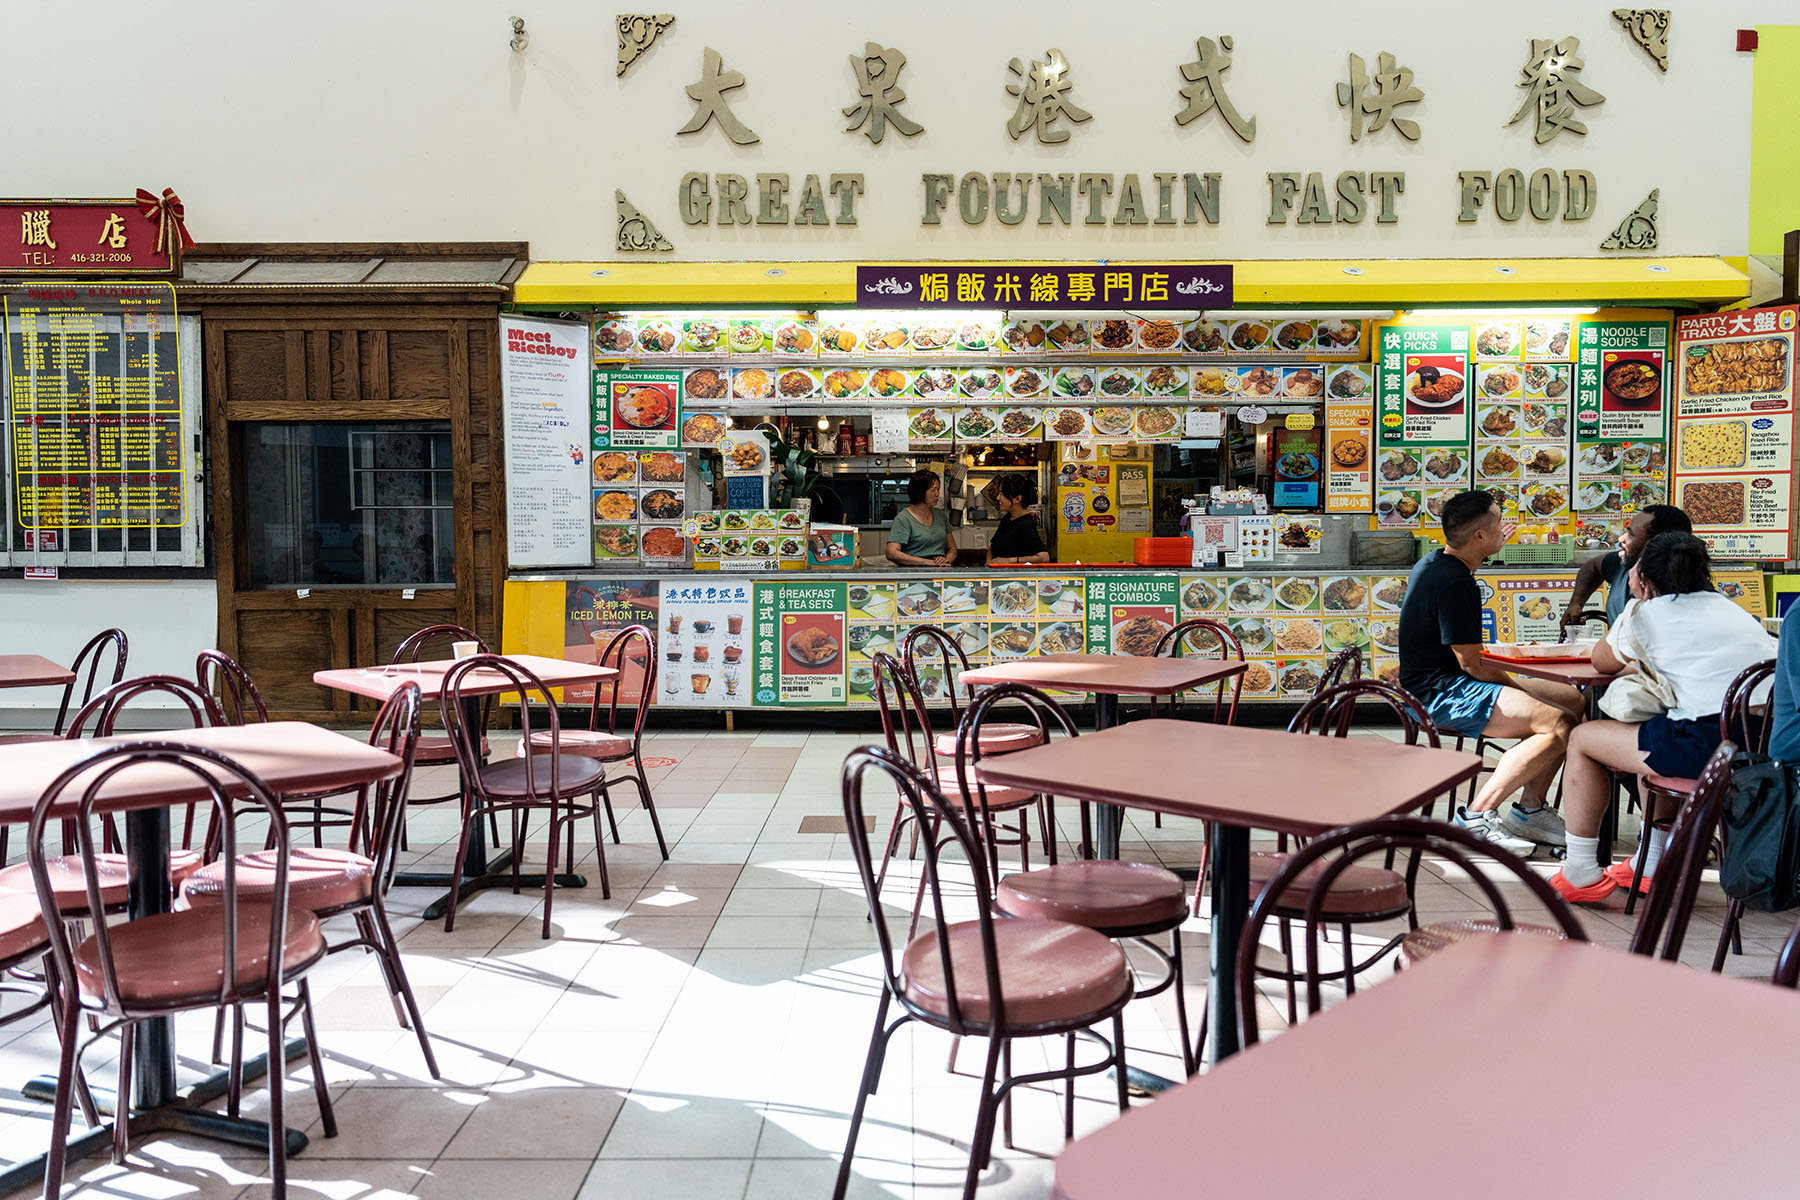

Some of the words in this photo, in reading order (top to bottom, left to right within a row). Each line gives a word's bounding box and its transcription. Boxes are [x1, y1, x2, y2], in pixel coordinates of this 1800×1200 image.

[676, 35, 1606, 146] 大泉港式快餐
[679, 171, 865, 227] GREAT
[921, 171, 1223, 227] FOUNTAIN
[1266, 169, 1405, 226] FAST
[1456, 168, 1597, 223] FOOD
[22, 252, 56, 265] TEL:
[70, 253, 132, 263] 416-321-2006
[919, 272, 1170, 302] 焗飯米線專門店
[1681, 315, 1727, 329] PARTY
[1729, 312, 1777, 335] 大盤
[508, 328, 551, 343] Meet
[1404, 331, 1439, 341] QUICK
[1601, 327, 1647, 337] NOODLE
[1681, 326, 1727, 339] TRAYS
[1404, 341, 1437, 350] PICKS
[1601, 337, 1639, 347] SOUPS
[508, 341, 577, 359] Riceboy
[1329, 409, 1371, 418] SPECIALTY
[1329, 418, 1356, 426] SNACK
[1121, 471, 1144, 480] PASS
[730, 488, 761, 497] COFFEE
[1109, 582, 1175, 592] SIGNATURE
[779, 589, 836, 599] BREAKFAST
[1109, 592, 1160, 602] COMBOS
[779, 600, 785, 609] &
[788, 600, 807, 609] TEA
[812, 600, 834, 609] SETS
[571, 610, 593, 620] ICED
[597, 610, 632, 620] LEMON
[635, 610, 654, 620] TEA
